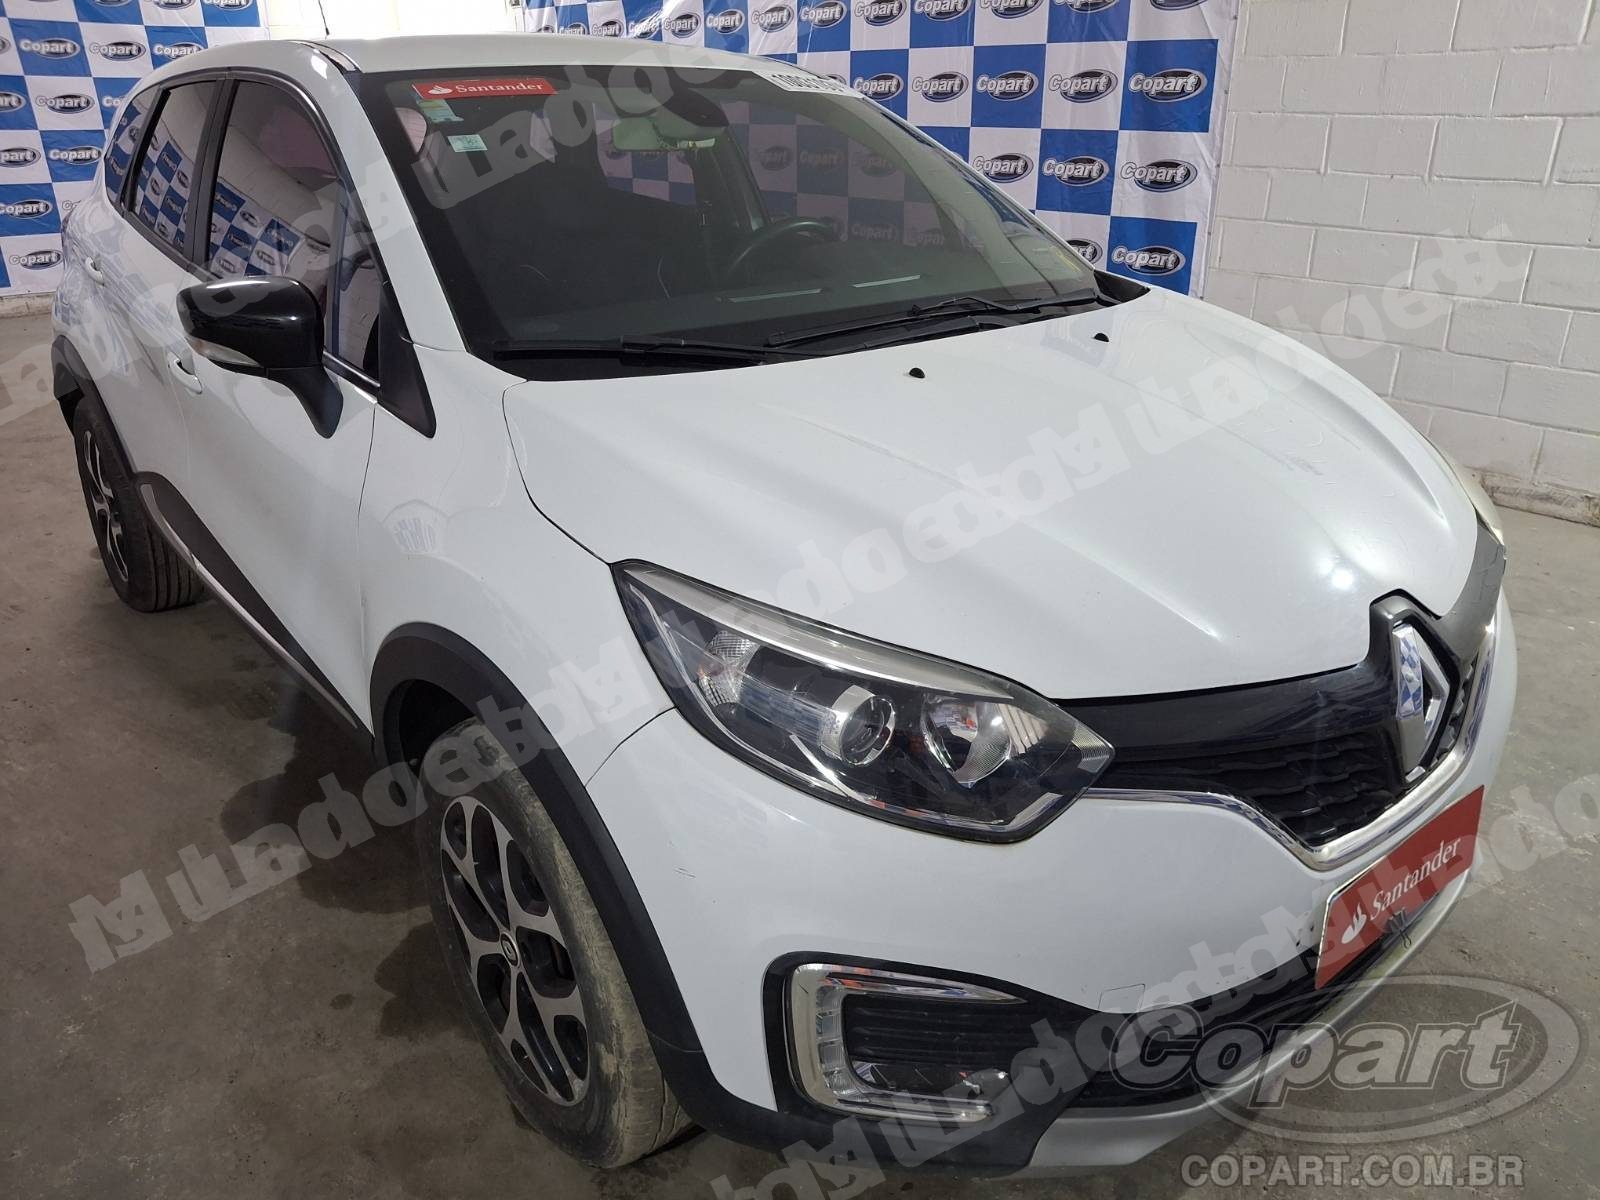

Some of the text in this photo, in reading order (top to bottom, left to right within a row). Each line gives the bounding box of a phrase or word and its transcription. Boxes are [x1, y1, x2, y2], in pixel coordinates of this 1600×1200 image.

[752, 8, 788, 26] Copart
[800, 5, 841, 24] Copart
[855, 0, 900, 19] Copart
[914, 0, 963, 16] Copart
[664, 15, 697, 32] Copart
[706, 12, 740, 29] Copart
[592, 24, 620, 37] Copart
[20, 39, 73, 54] Copart
[89, 42, 139, 57] Copart
[153, 43, 198, 59] Copart
[455, 82, 544, 93] Santander
[853, 77, 897, 95] Copart
[912, 76, 962, 95] Copart
[976, 72, 1031, 95] Copart
[1049, 74, 1109, 96] Copart
[1129, 72, 1198, 95] Copart
[35, 95, 88, 109] Copart
[0, 151, 33, 163] part
[49, 149, 100, 162] Copart
[973, 156, 1026, 176] Copart
[1043, 158, 1101, 178] Copart
[1120, 162, 1186, 183] Copart
[9, 249, 58, 266] Copart
[1112, 246, 1176, 269] Copart
[1370, 837, 1461, 920] Santander
